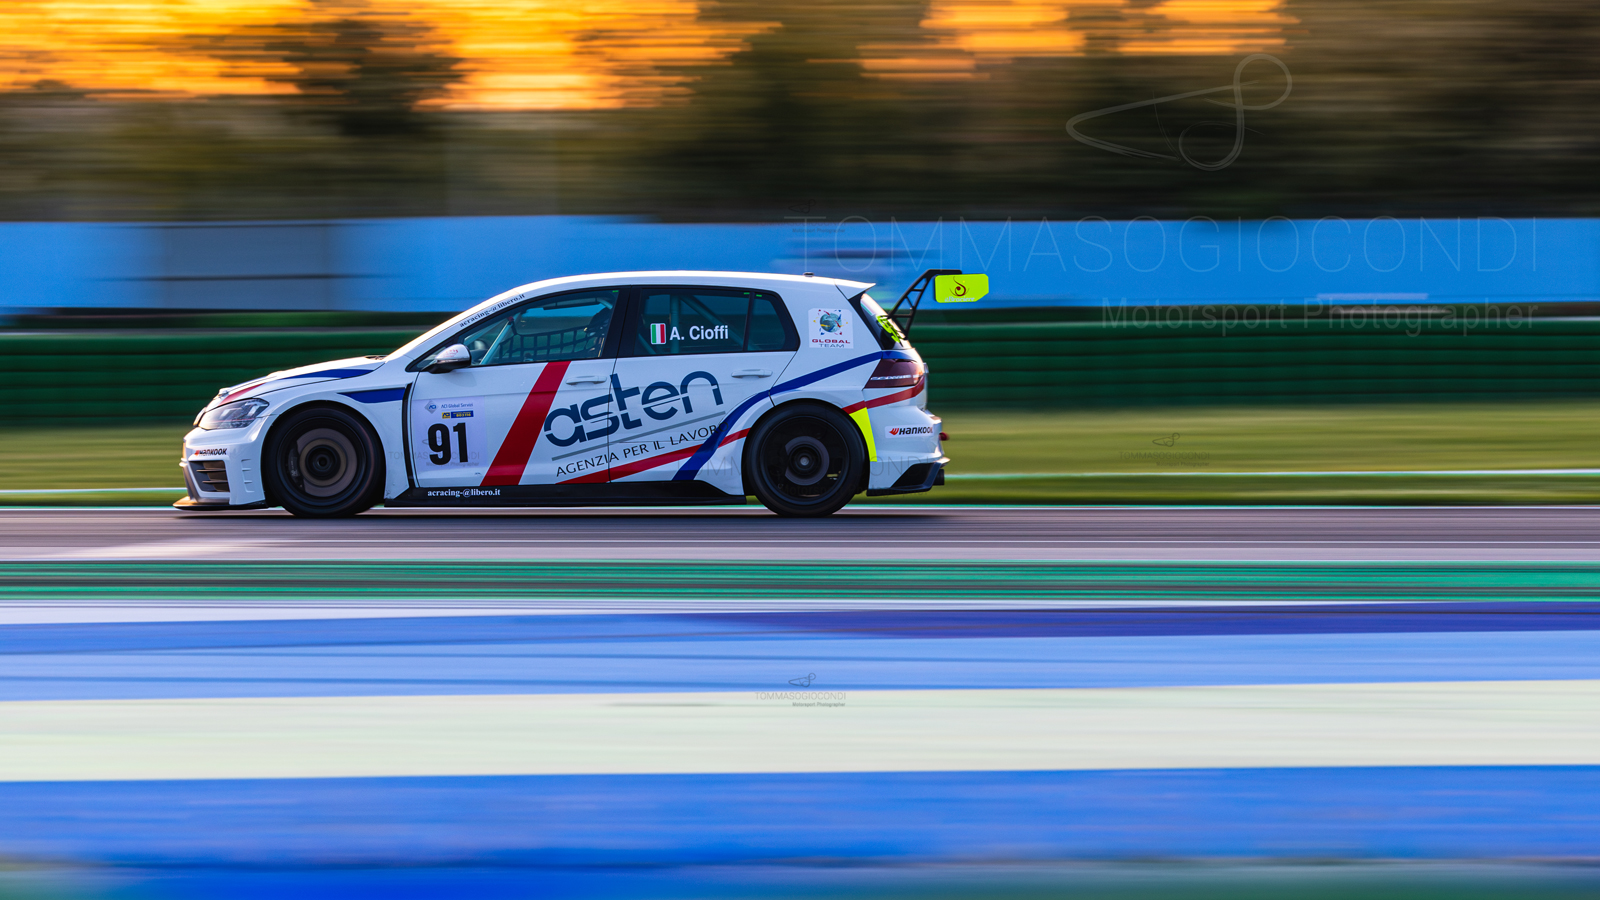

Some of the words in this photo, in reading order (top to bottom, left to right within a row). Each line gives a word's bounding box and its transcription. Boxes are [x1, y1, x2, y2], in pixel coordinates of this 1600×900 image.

[669, 326, 685, 340] A.
[689, 325, 729, 340] Cioffi
[543, 370, 723, 447] asten
[428, 422, 468, 466] 91
[556, 452, 619, 477] AGENZIA
[623, 443, 649, 459] PER
[653, 440, 665, 450] IL
[670, 422, 729, 446] LAVORO
[427, 488, 501, 498] acracing-@libero.it
